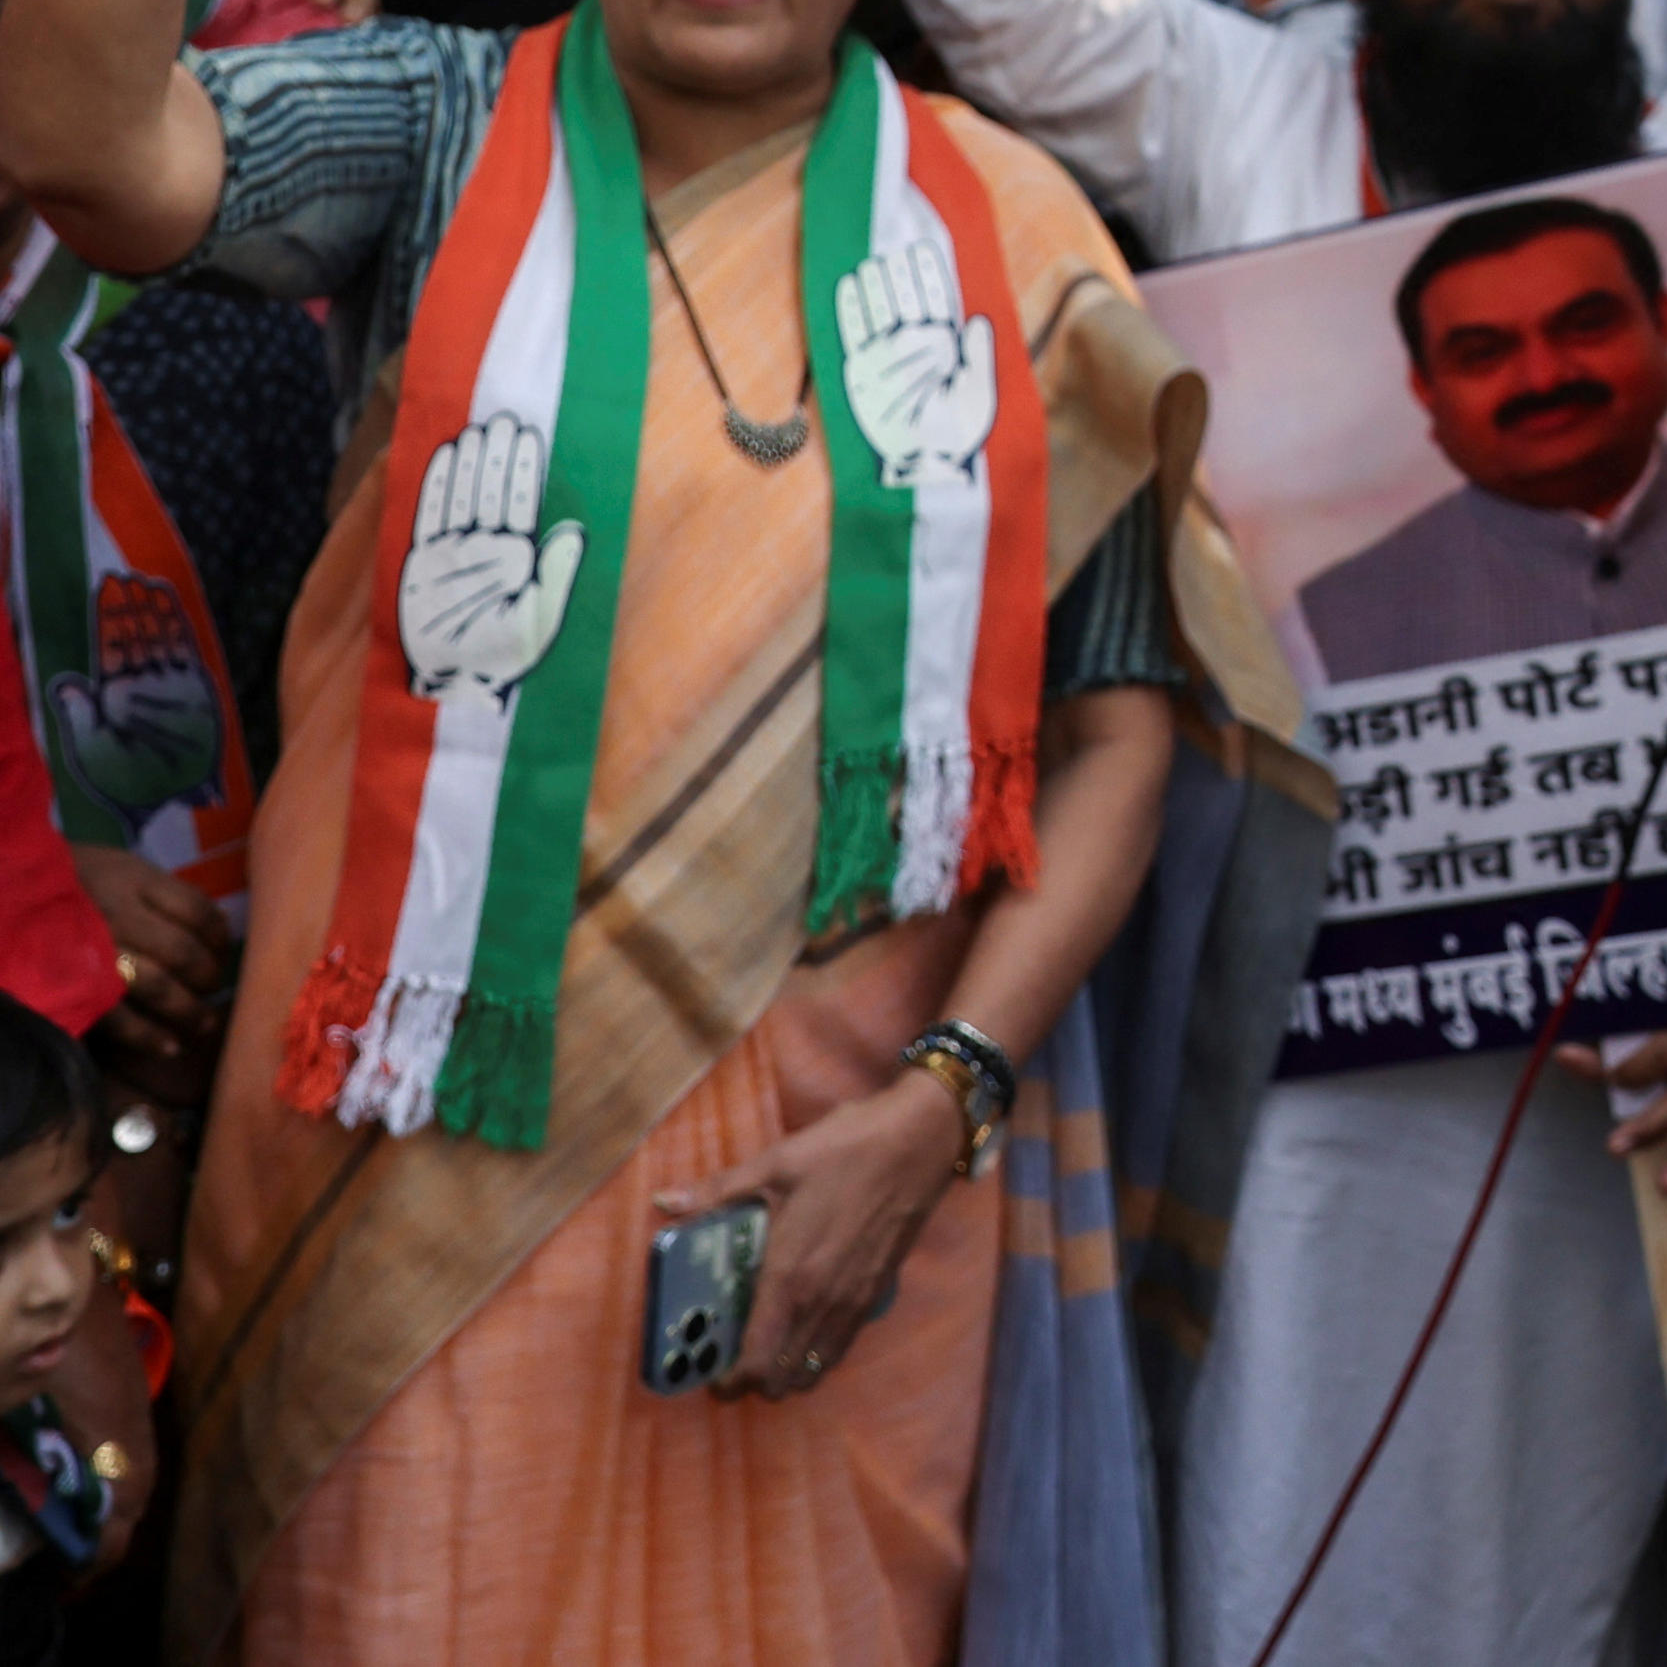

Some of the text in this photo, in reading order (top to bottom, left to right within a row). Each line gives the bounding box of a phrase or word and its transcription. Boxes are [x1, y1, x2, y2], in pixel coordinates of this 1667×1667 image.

[1497, 648, 1603, 721] पोर्ट
[1429, 743, 1513, 811] गई
[1525, 740, 1625, 796] तब
[1395, 830, 1516, 893] जांच
[1321, 965, 1425, 1034] मध्य
[1422, 918, 1536, 1049] मुंबई
